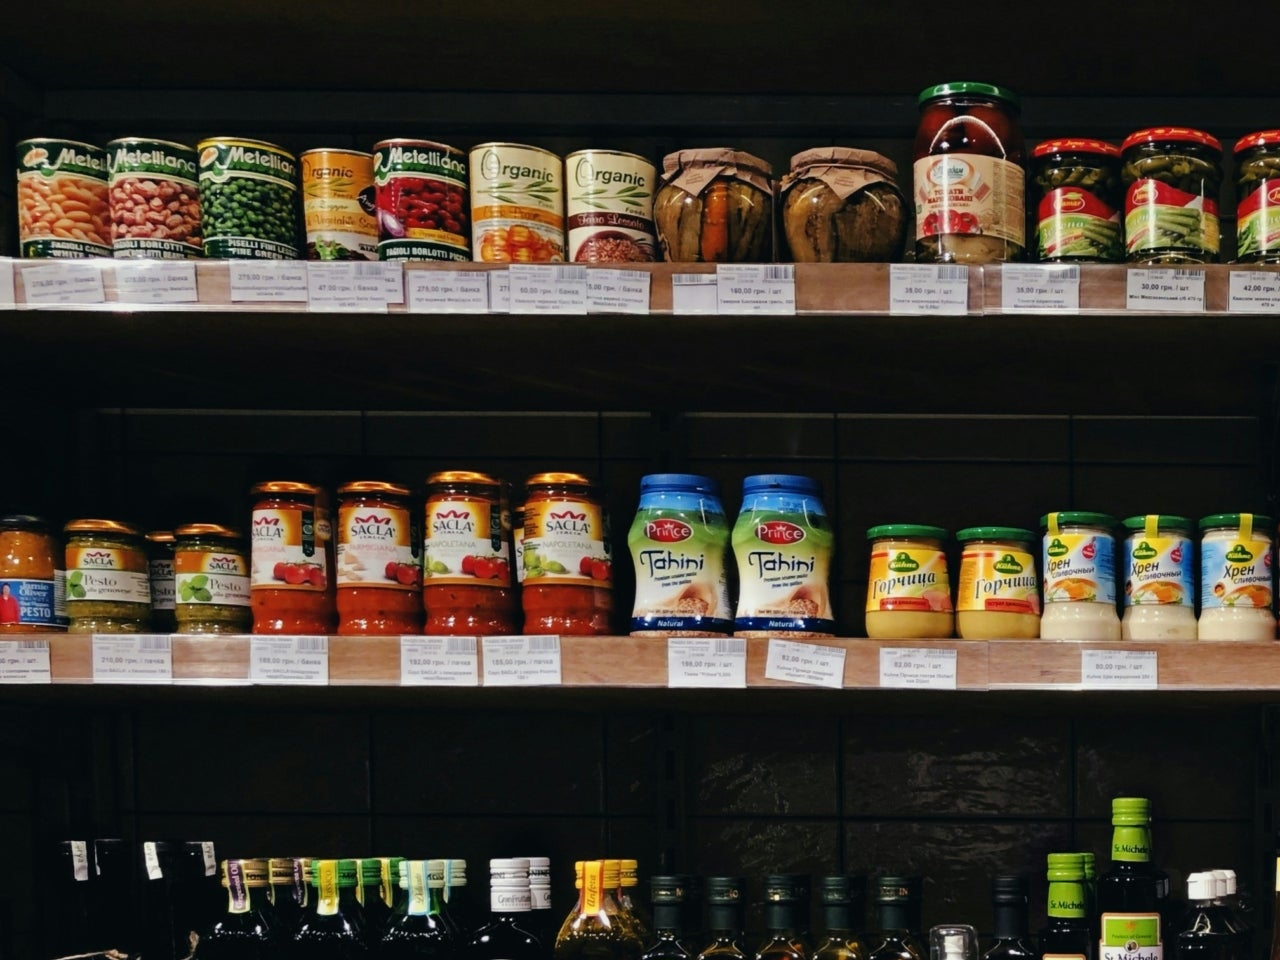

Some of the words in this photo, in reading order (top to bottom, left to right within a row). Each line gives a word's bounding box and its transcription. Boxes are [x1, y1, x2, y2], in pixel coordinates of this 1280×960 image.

[108, 147, 197, 174] Metelliana
[220, 147, 297, 176] Metellian
[480, 149, 554, 183] Organic
[574, 152, 646, 188] Organic
[647, 520, 690, 541] Prince
[758, 522, 803, 541] Prince
[640, 550, 704, 577] Tahini
[749, 551, 815, 579] Tahini
[1047, 558, 1071, 573] Хрен
[1131, 562, 1159, 577] Хрен
[1223, 564, 1255, 580] Хрен
[84, 574, 117, 587] Pesto
[210, 579, 242, 592] Pesto
[873, 573, 936, 600] Горчица
[975, 576, 1035, 600] Горчица
[20, 607, 51, 618] PESTO
[658, 619, 683, 628] Natural
[769, 620, 795, 629] Natural
